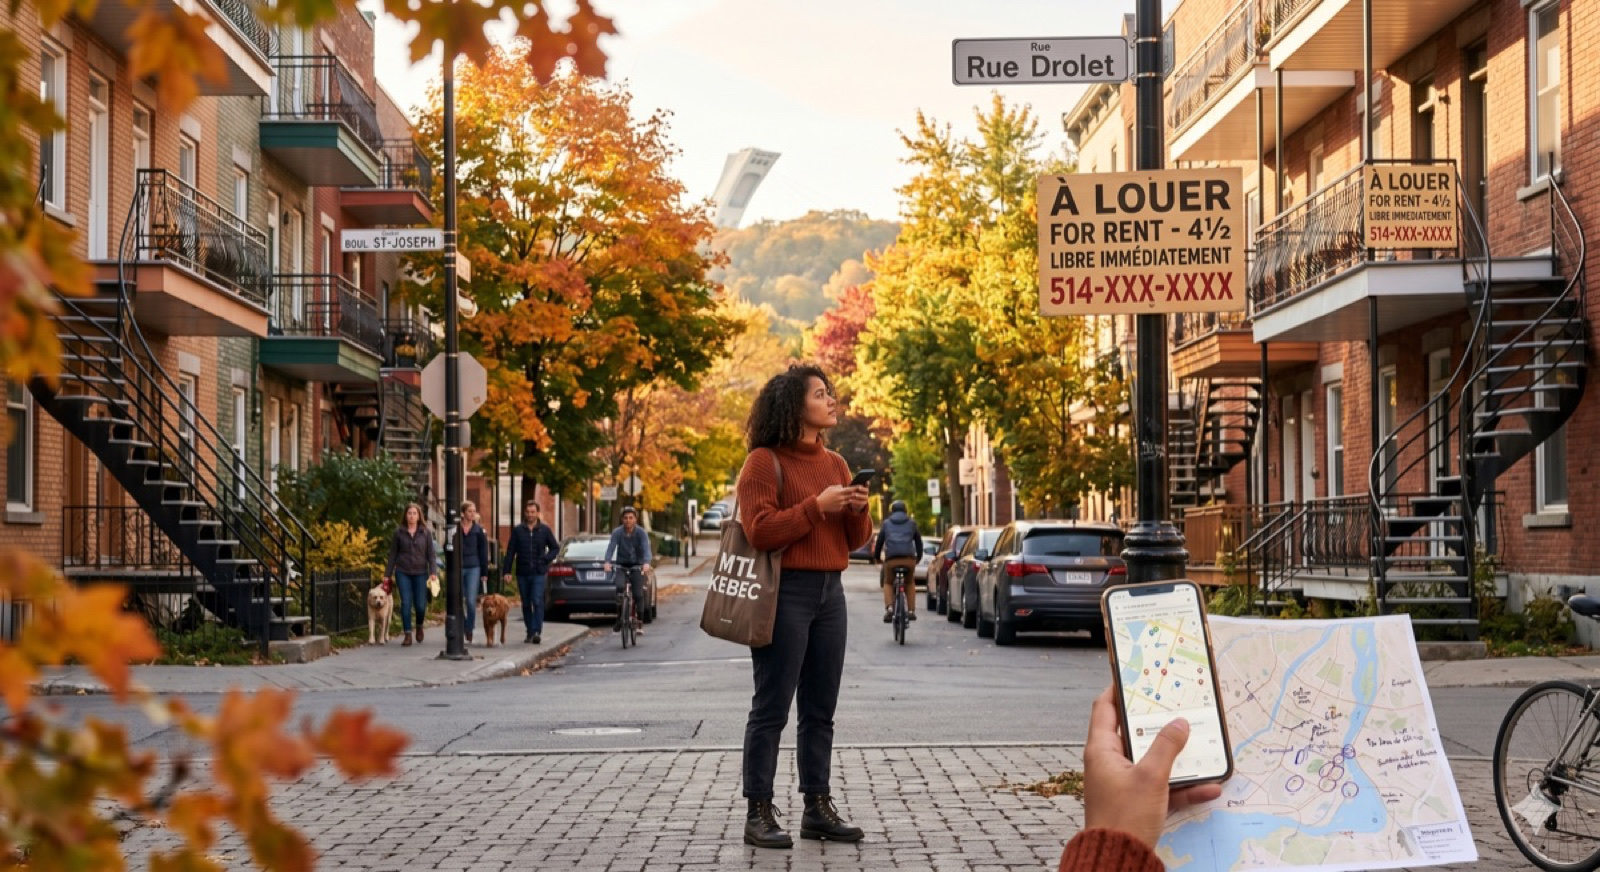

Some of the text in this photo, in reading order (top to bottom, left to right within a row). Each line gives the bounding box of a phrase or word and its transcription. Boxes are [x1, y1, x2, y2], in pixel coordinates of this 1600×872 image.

[1030, 42, 1051, 52] Rue
[967, 54, 1115, 78] Rue Drolet
[1370, 168, 1450, 191] À LOUER
[1050, 176, 1232, 216] À LOUER
[1369, 194, 1391, 208] FOR
[1394, 194, 1421, 208] RENT
[1431, 194, 1451, 208] 4½
[1369, 211, 1390, 221] LIBRE
[373, 236, 436, 249] ST-JOSEPH
[1051, 222, 1096, 245] FOR
[1103, 219, 1164, 244] RENT
[1187, 216, 1232, 241] 4½
[1370, 226, 1453, 242] 514-XXX-XXXX
[1050, 245, 1232, 269] LIBRE IMMÉDIATEMENT
[1050, 271, 1234, 306] 514-XXX-XXXX
[718, 552, 758, 580] MTL
[708, 574, 762, 600] KEBEC
